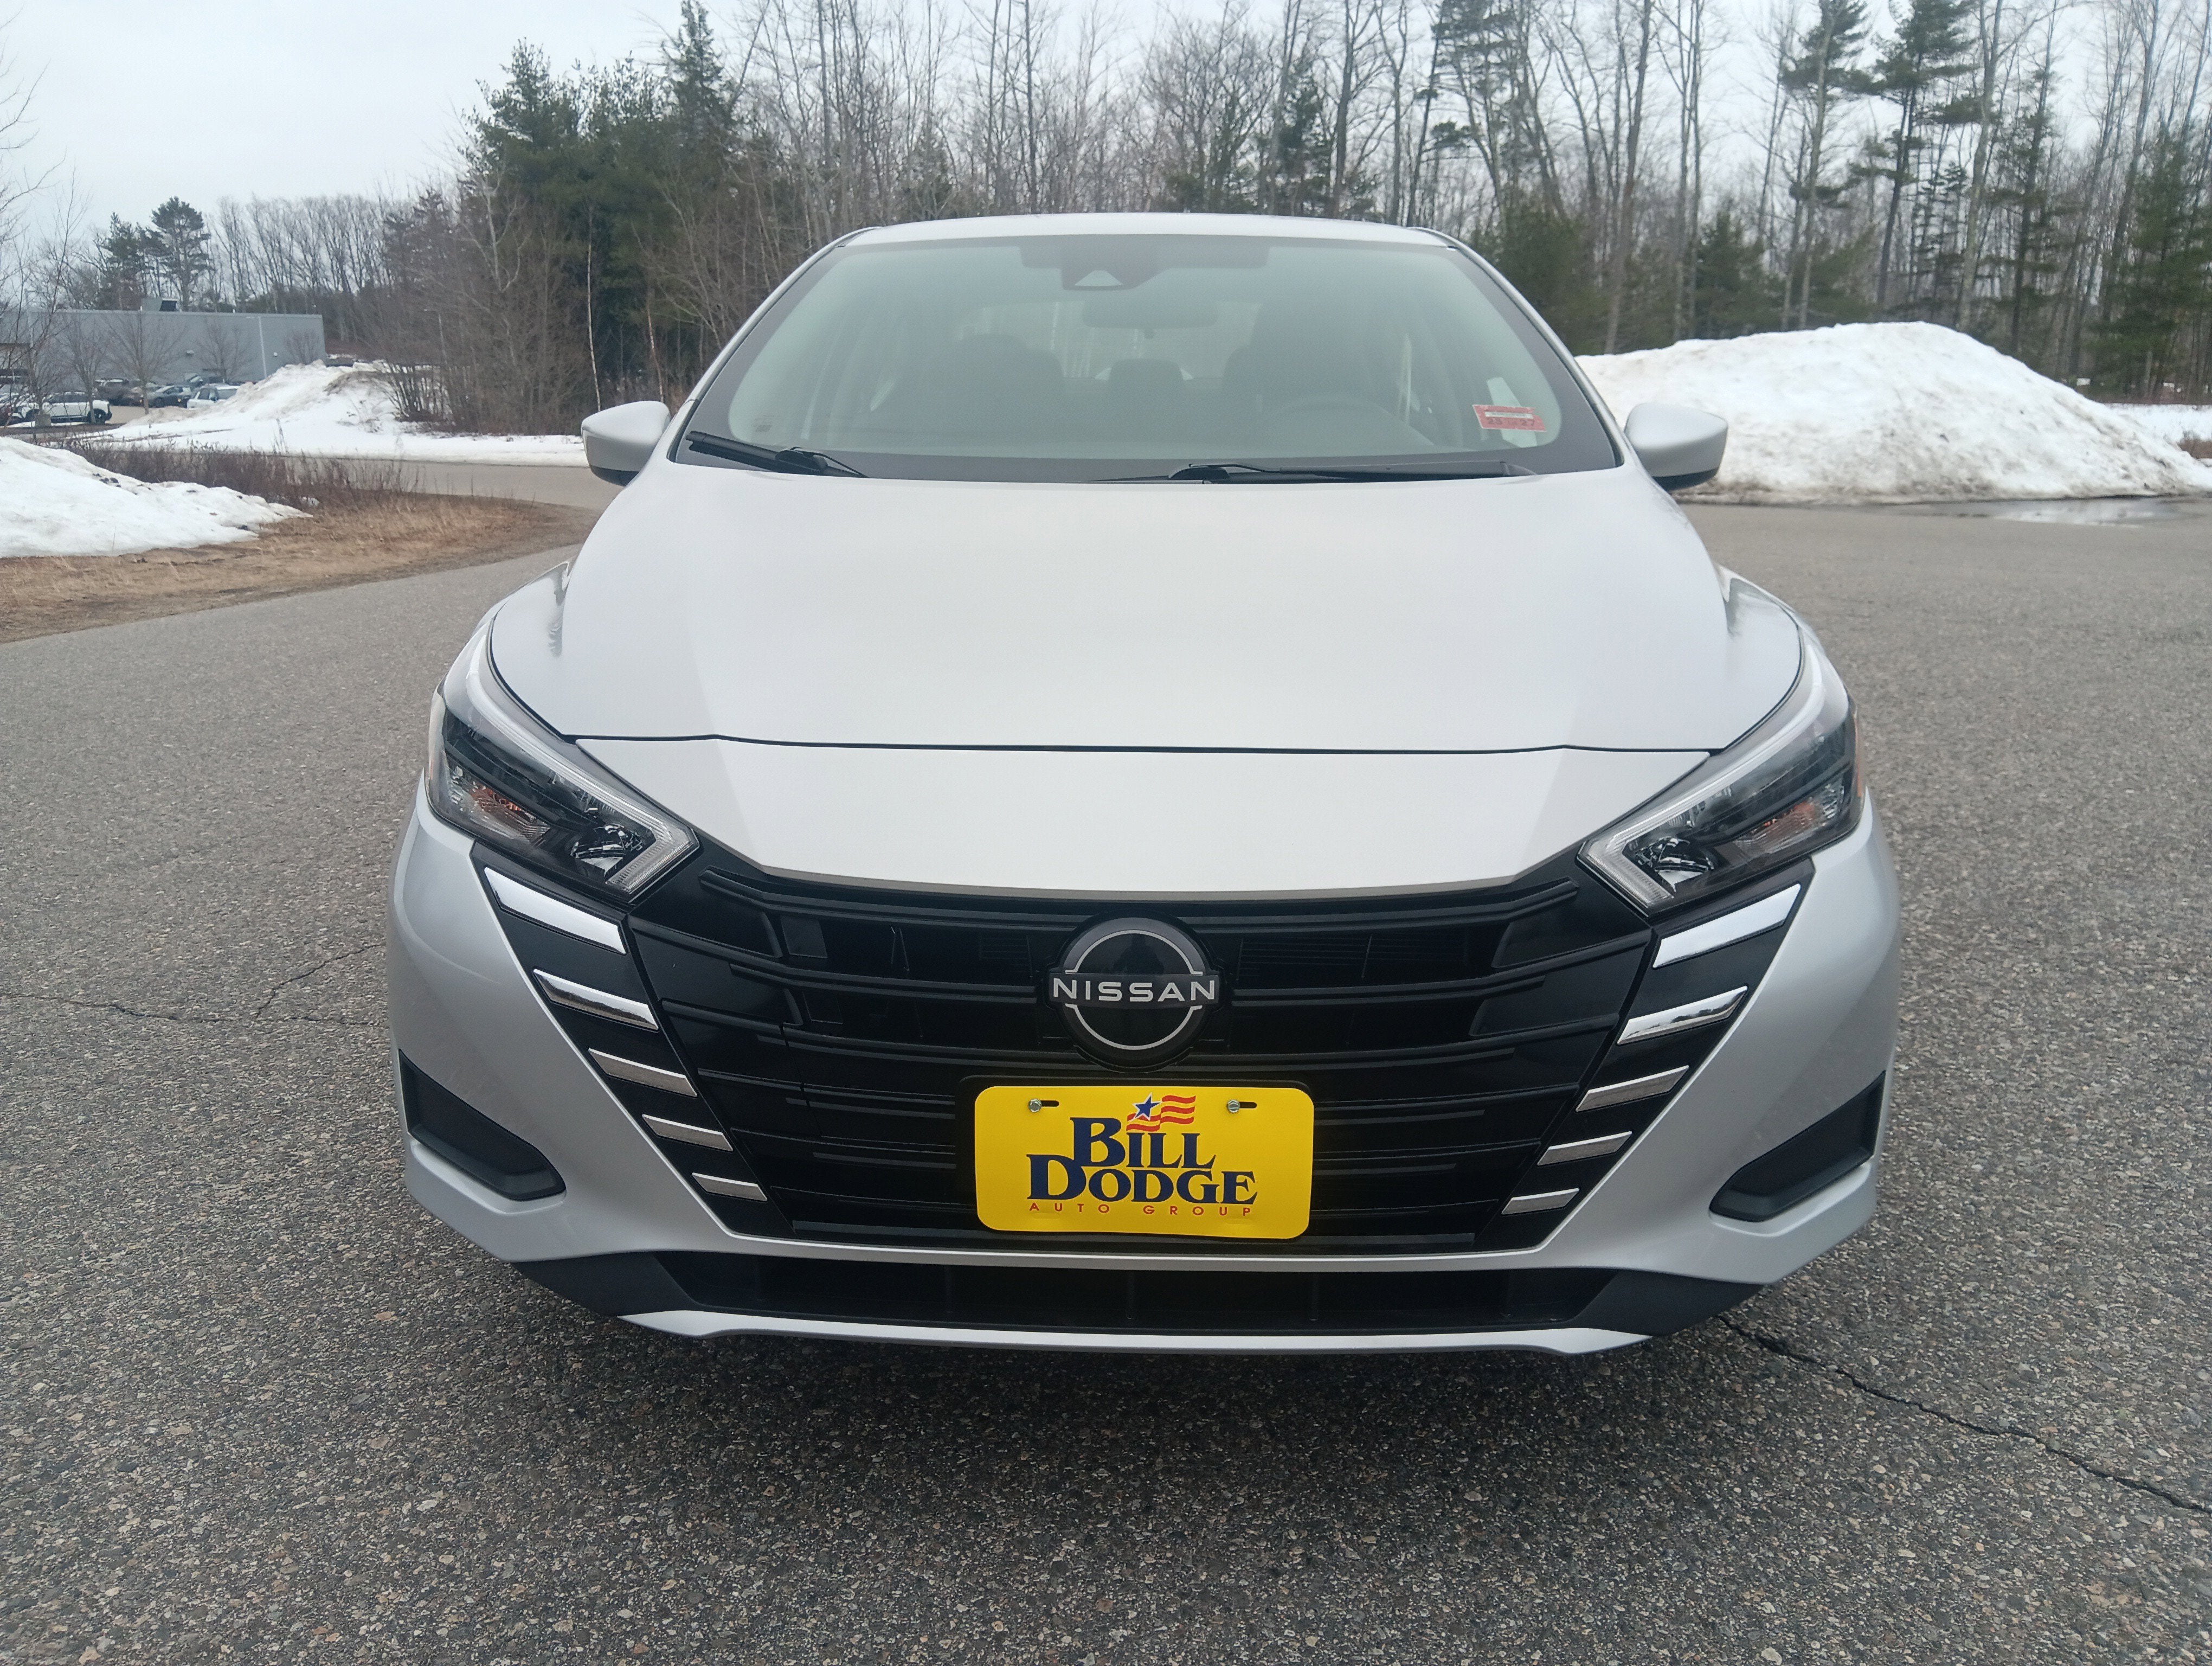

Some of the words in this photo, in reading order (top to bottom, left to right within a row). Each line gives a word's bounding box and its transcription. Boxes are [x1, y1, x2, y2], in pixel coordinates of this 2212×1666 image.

[1053, 978, 1215, 1002] NISSAN
[1070, 1117, 1216, 1169] BILL
[1026, 1154, 1258, 1205] DODGE
[1029, 1202, 1110, 1213] AUTO
[1143, 1205, 1251, 1216] GROUP
